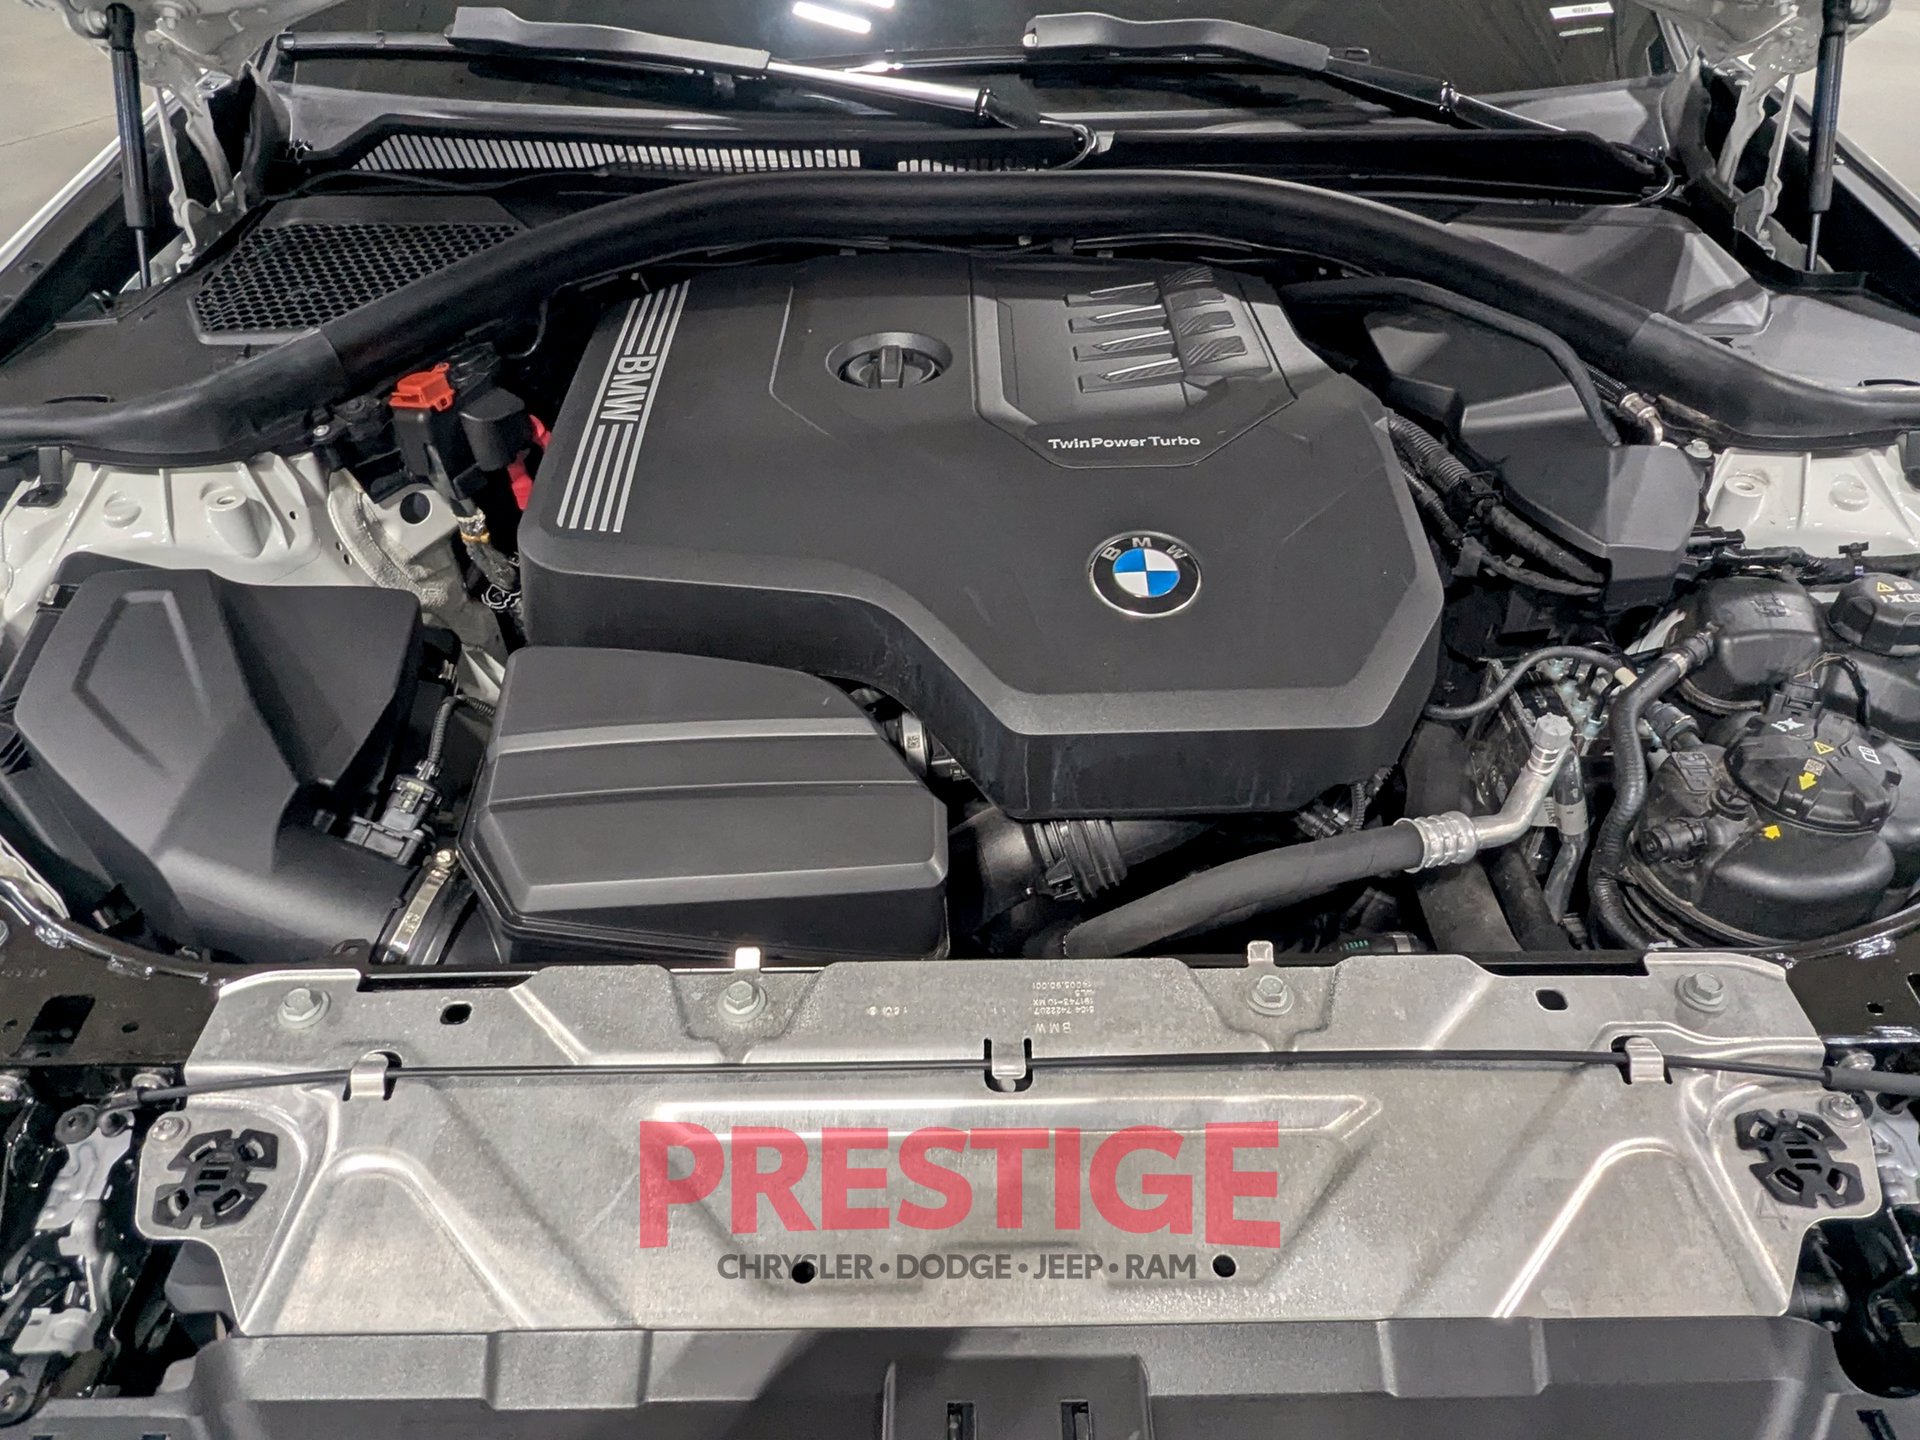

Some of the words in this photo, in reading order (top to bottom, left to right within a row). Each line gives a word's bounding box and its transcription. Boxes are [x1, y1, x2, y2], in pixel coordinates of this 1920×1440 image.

[600, 356, 658, 422] BMW
[1048, 437, 1146, 449] TwinPower
[1147, 436, 1201, 447] Turbo
[1101, 537, 1188, 561] BMW
